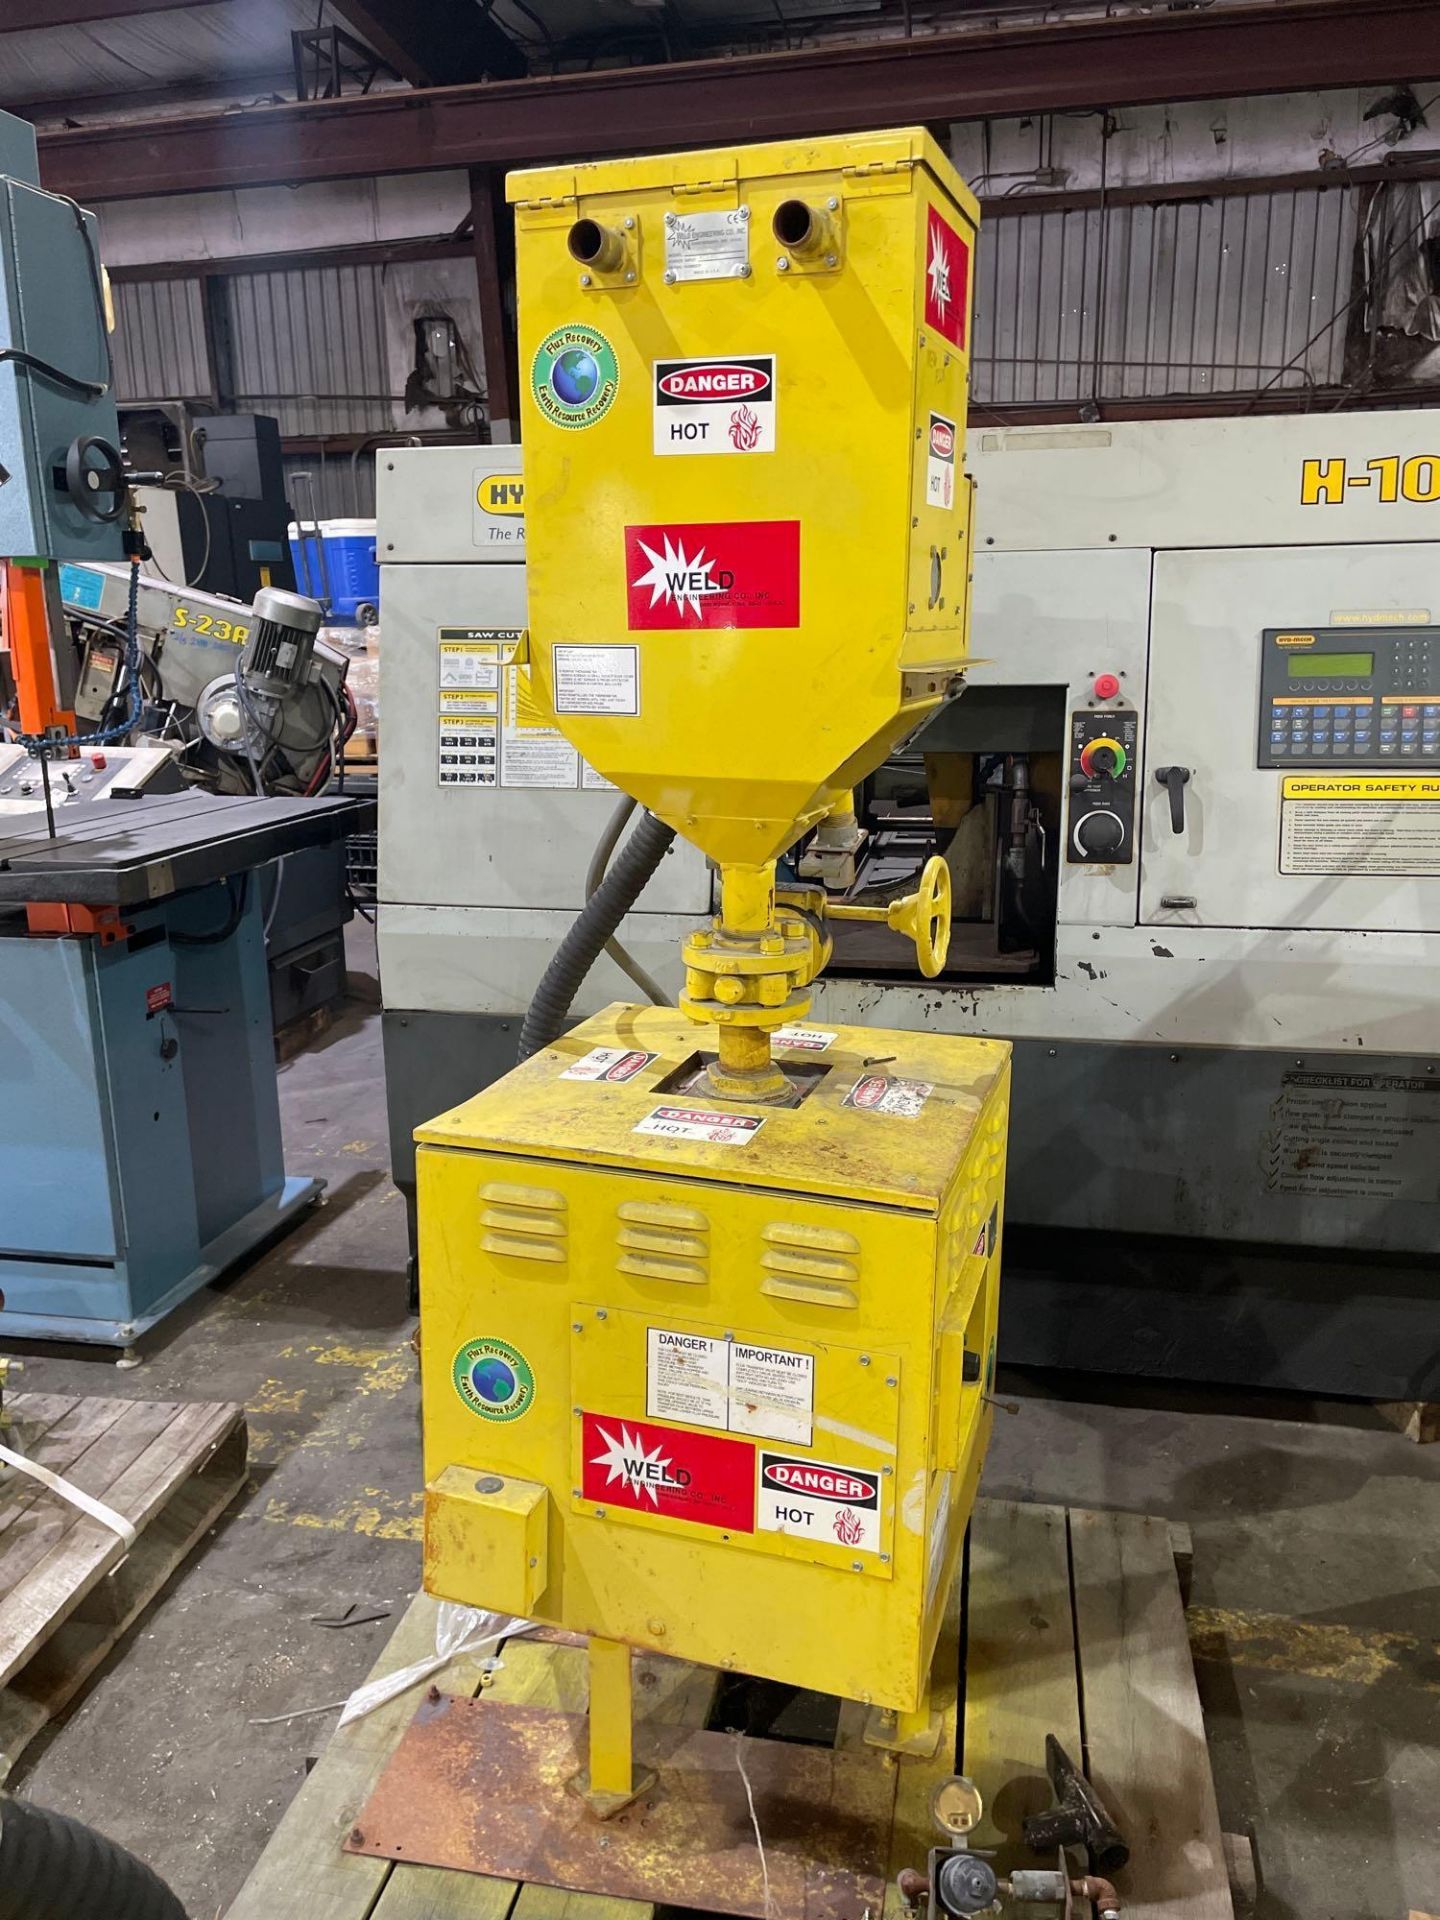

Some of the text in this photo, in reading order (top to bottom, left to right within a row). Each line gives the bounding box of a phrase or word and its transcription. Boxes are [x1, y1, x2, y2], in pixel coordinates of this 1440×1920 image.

[545, 332, 603, 355] Flux Recovery
[670, 373, 755, 393] DANGER
[539, 380, 614, 422] Earth Resource Recovery
[671, 423, 709, 440] HOT
[932, 429, 951, 449] DANGER
[930, 475, 941, 493] HOT
[488, 527, 511, 540] The
[666, 571, 735, 591] WELD
[671, 592, 731, 601] ENGINEERING
[174, 607, 250, 646] S-23A
[1296, 1076, 1347, 1086] CHECKLIST
[1373, 1079, 1425, 1089] OPERATOR
[668, 1110, 747, 1126] DANGER
[653, 1124, 691, 1134] HOT
[658, 1333, 713, 1352] DANGER !
[467, 1344, 519, 1367] Flux Recovery
[735, 1347, 809, 1370] IMPORTANT !
[460, 1376, 529, 1415] Earth Resource Recovery
[623, 1457, 691, 1487] WELD
[775, 1466, 863, 1497] DANGER
[626, 1478, 688, 1496] ENGINEERING
[775, 1505, 814, 1525] HOT
